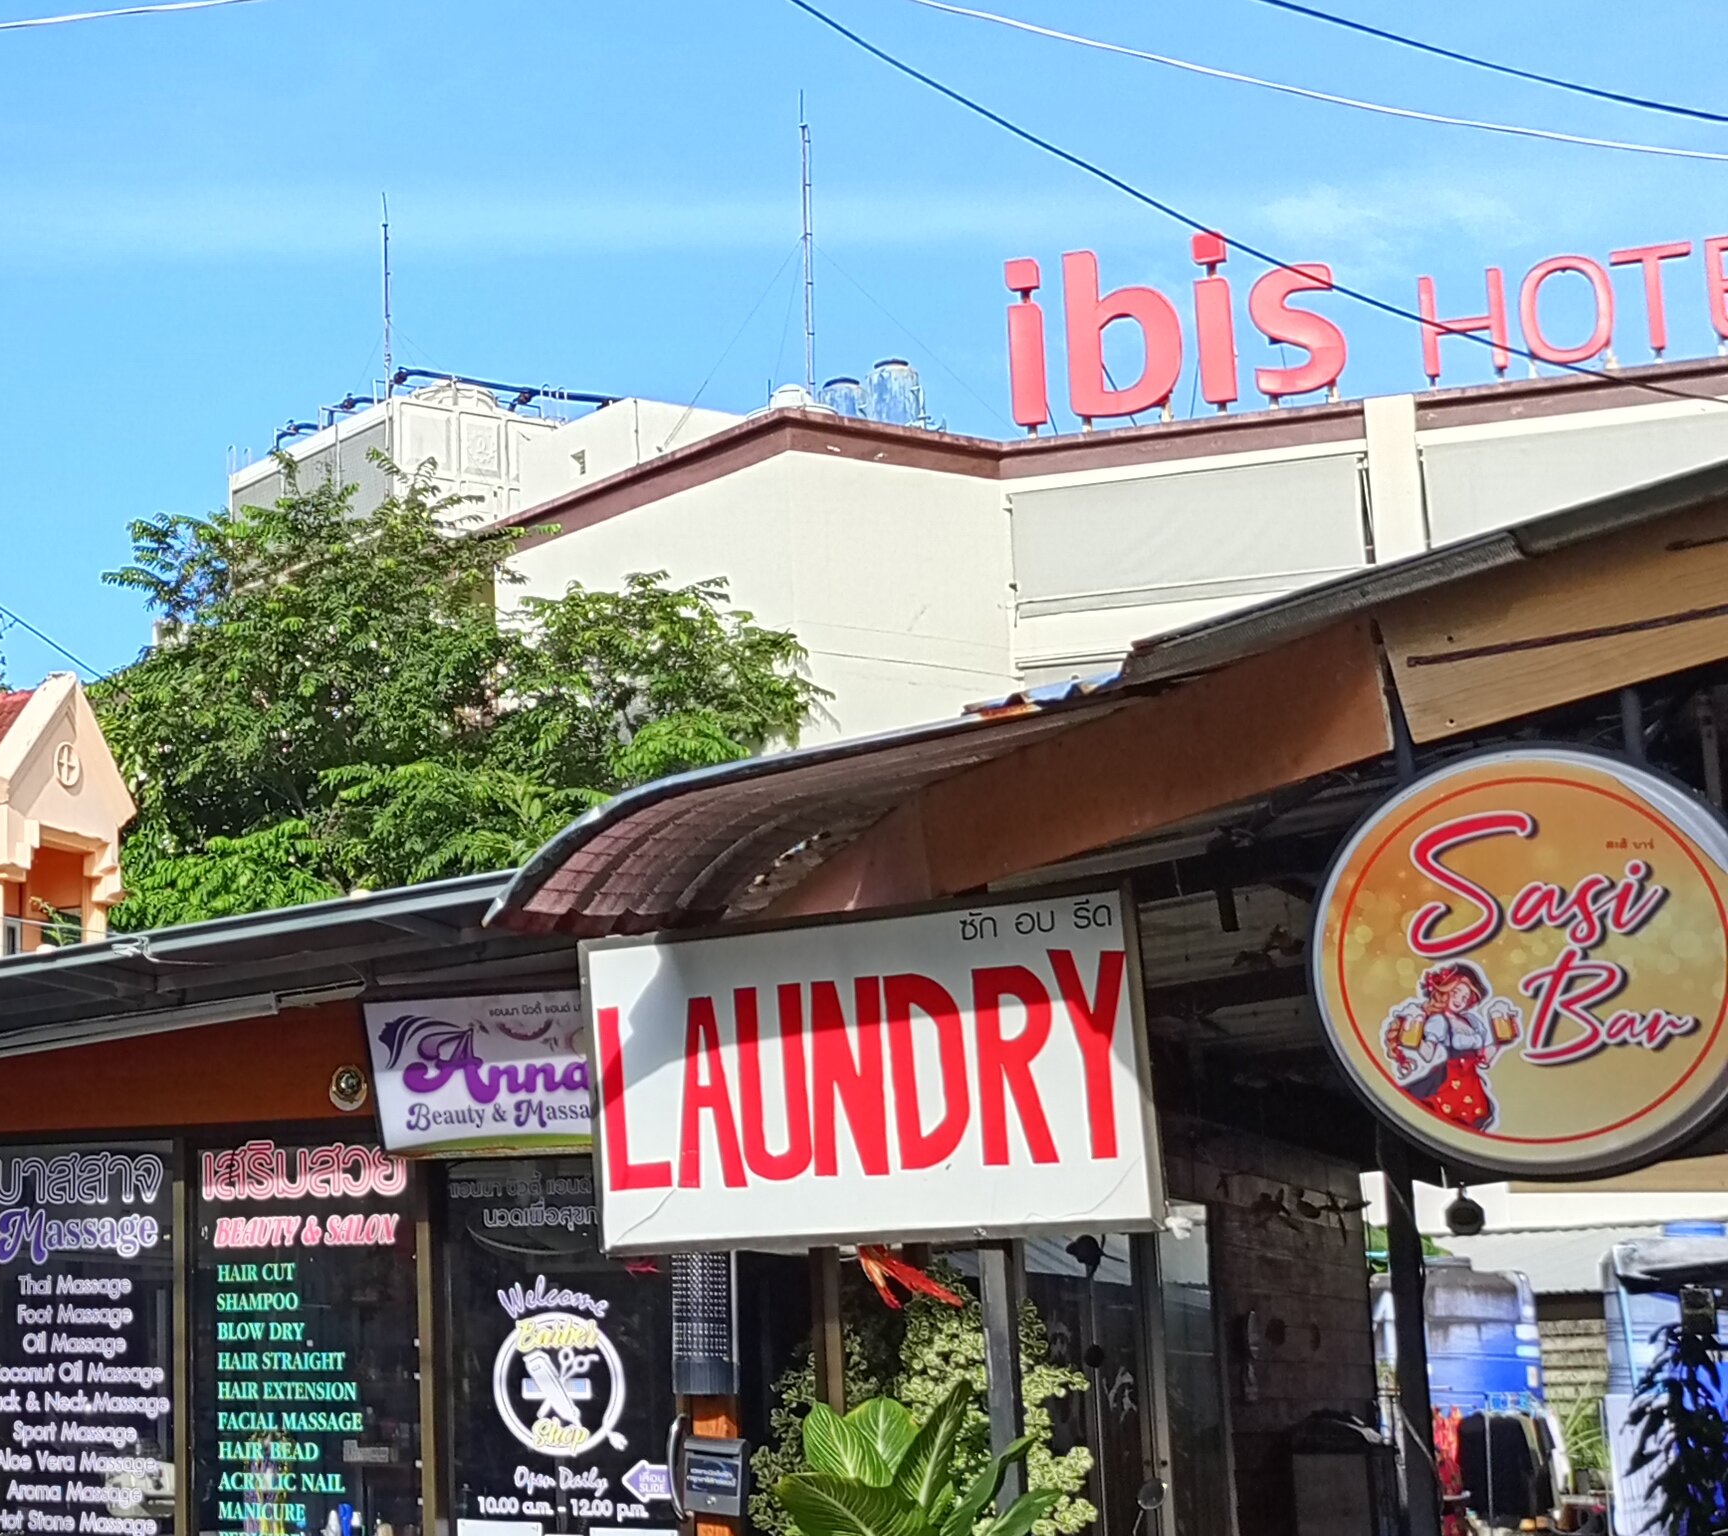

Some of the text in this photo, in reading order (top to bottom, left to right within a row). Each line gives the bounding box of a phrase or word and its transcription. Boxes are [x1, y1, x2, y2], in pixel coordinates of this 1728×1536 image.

[1004, 230, 1347, 426] ibis
[1408, 810, 1666, 954] Sasi
[959, 899, 1112, 940] ซัก อบ รีด
[1519, 944, 1699, 1064] Bar
[403, 1027, 591, 1104] Anna
[597, 948, 1126, 1191] LAUNDRY
[406, 1102, 486, 1132] Beauty
[491, 1103, 508, 1123] &
[202, 1140, 408, 1201] เสริมสวย
[214, 1213, 400, 1248] BEAUTY & SALON
[17, 1274, 132, 1299] Thai Massage
[217, 1263, 297, 1282] HAIR CUT
[216, 1292, 299, 1311] SHAMPOO
[497, 1274, 609, 1318] Welcome
[17, 1303, 133, 1329] Foot Massage
[22, 1331, 127, 1358] Oil Massage
[217, 1322, 305, 1341] BLOW DRY
[515, 1317, 600, 1353] Barber
[59, 1360, 83, 1383] Oil
[87, 1362, 164, 1388] Massage
[217, 1352, 346, 1371] HAIR STRAIGHT
[25, 1391, 41, 1412] &
[44, 1389, 87, 1413] Neck
[92, 1391, 170, 1419] Massage
[217, 1382, 357, 1402] HAIR EXTENSION
[13, 1420, 137, 1448] Sport Massage
[217, 1412, 363, 1432] FACIAL MASSAGE
[531, 1416, 590, 1456] Shop
[36, 1450, 75, 1472] Vera
[79, 1451, 157, 1478] Massage
[218, 1441, 319, 1461] HAIR BEAD
[6, 1480, 143, 1508] Aroma Massage
[218, 1472, 345, 1493] ACRYLIC NAIL
[514, 1466, 609, 1496] Open Daily
[639, 1483, 665, 1493] SLIDE
[219, 1502, 305, 1521] MANICURE
[477, 1496, 519, 1514] 10.00
[570, 1498, 613, 1516] 12.00
[28, 1510, 75, 1532] Stone
